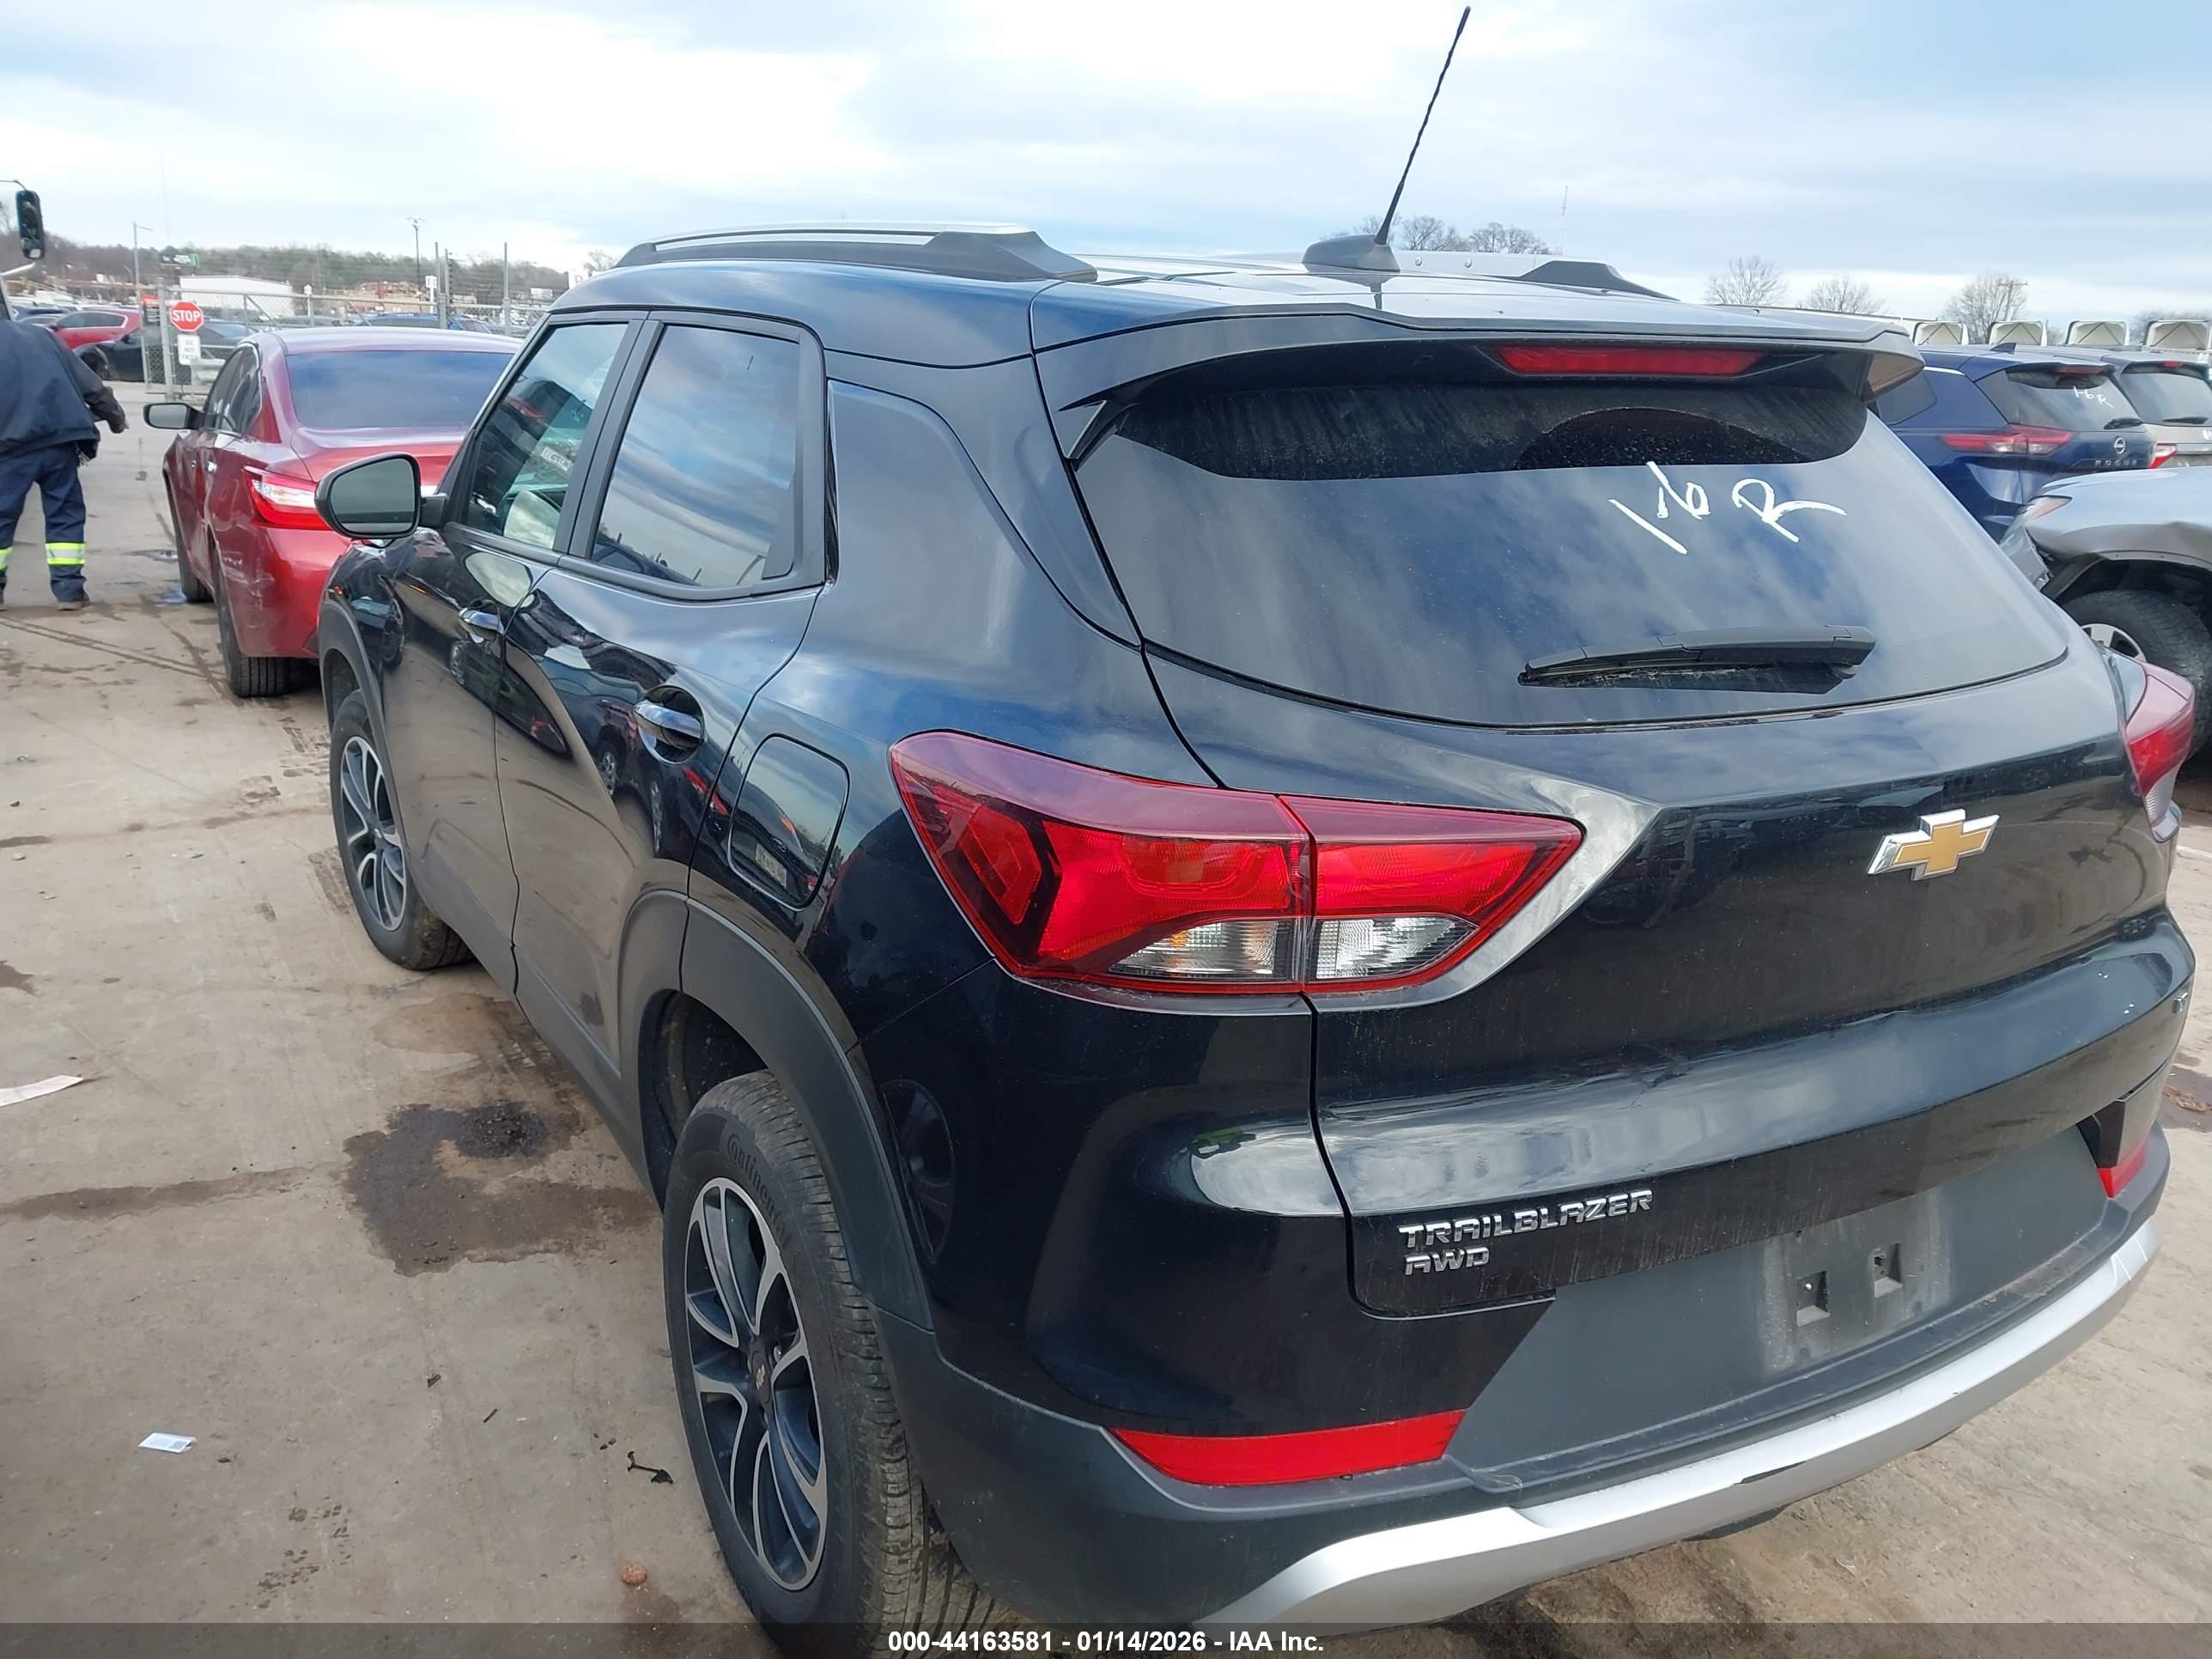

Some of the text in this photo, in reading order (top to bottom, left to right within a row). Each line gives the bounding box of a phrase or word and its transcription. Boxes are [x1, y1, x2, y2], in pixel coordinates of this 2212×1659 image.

[172, 310, 201, 322] STOP
[1398, 1190, 1653, 1248] TRAILBLAZER
[1405, 1247, 1490, 1275] AWD
